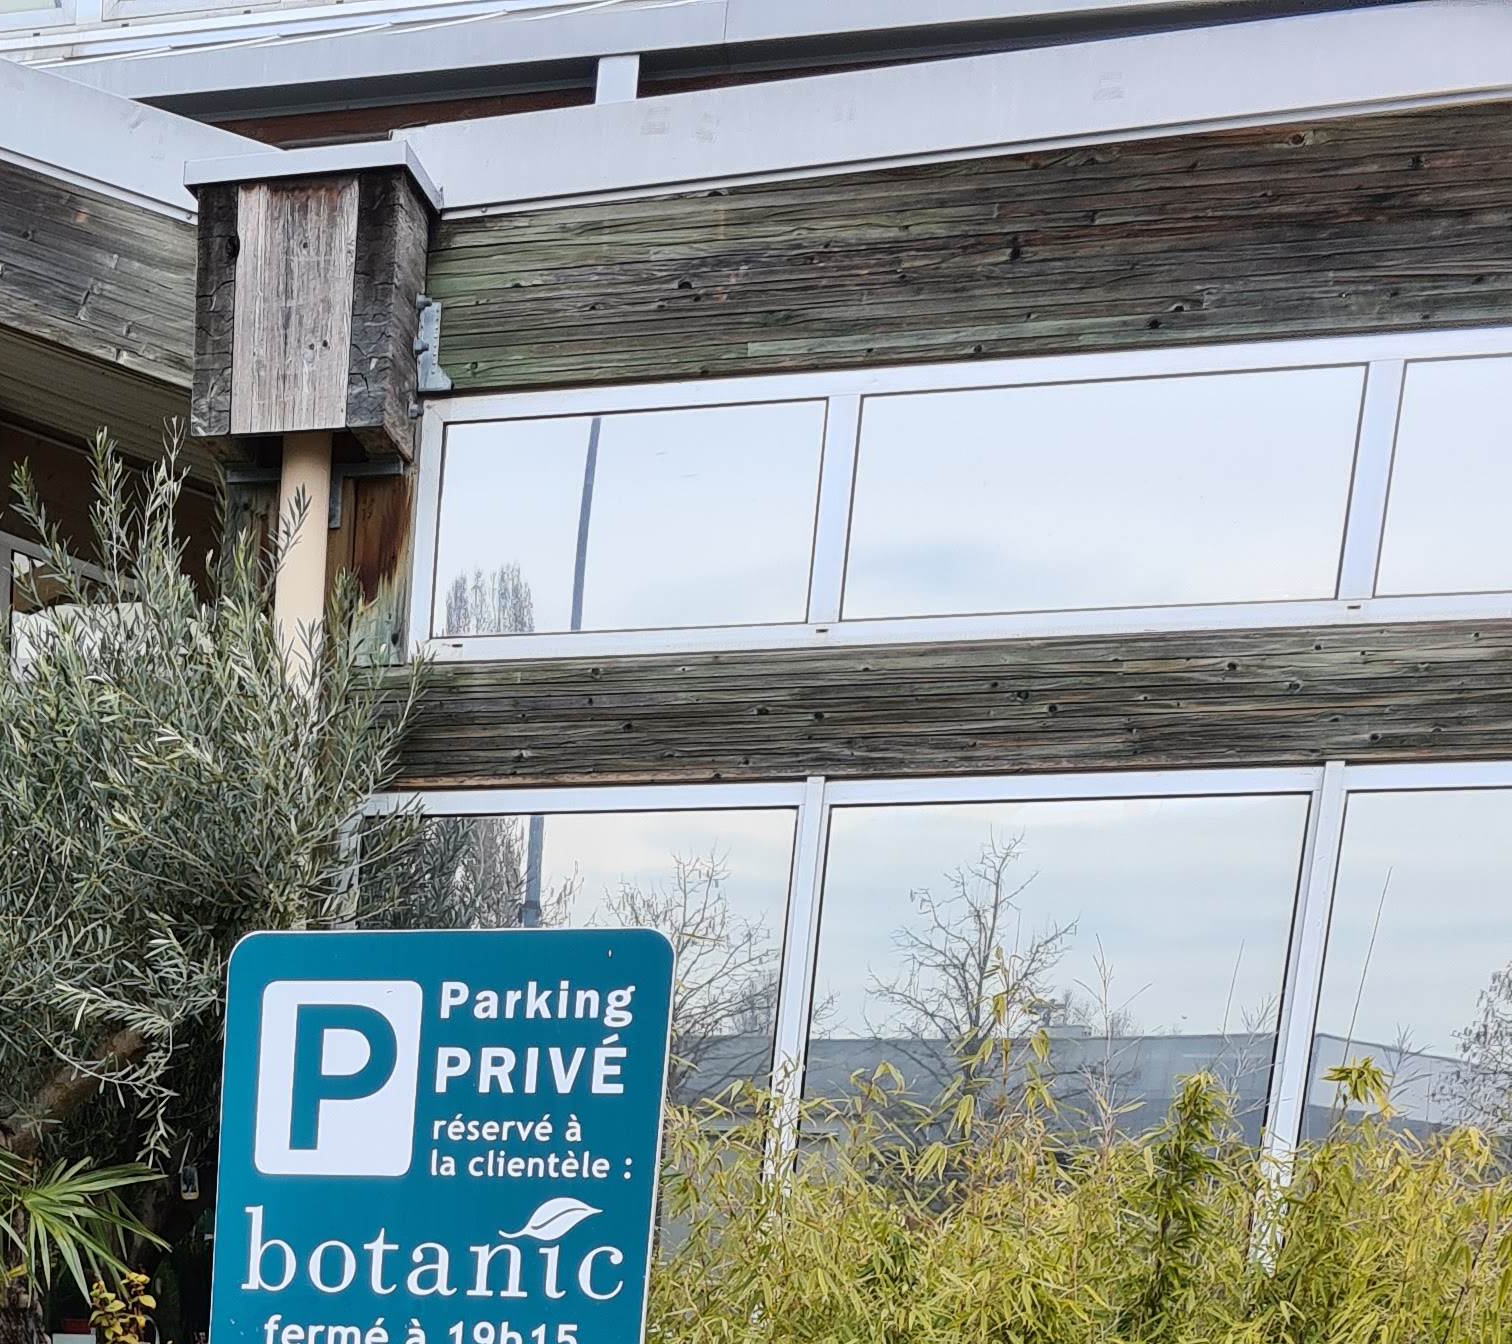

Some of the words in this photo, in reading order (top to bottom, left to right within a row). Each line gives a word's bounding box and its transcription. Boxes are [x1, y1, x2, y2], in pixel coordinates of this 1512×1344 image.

[439, 980, 636, 1028] Parking
[289, 1003, 398, 1150] P
[434, 1033, 628, 1095] PRIVÉ
[432, 1113, 553, 1142] réservé
[565, 1113, 583, 1142] à
[430, 1149, 456, 1177] la
[468, 1149, 611, 1180] clientèle
[240, 1203, 625, 1301] botanic
